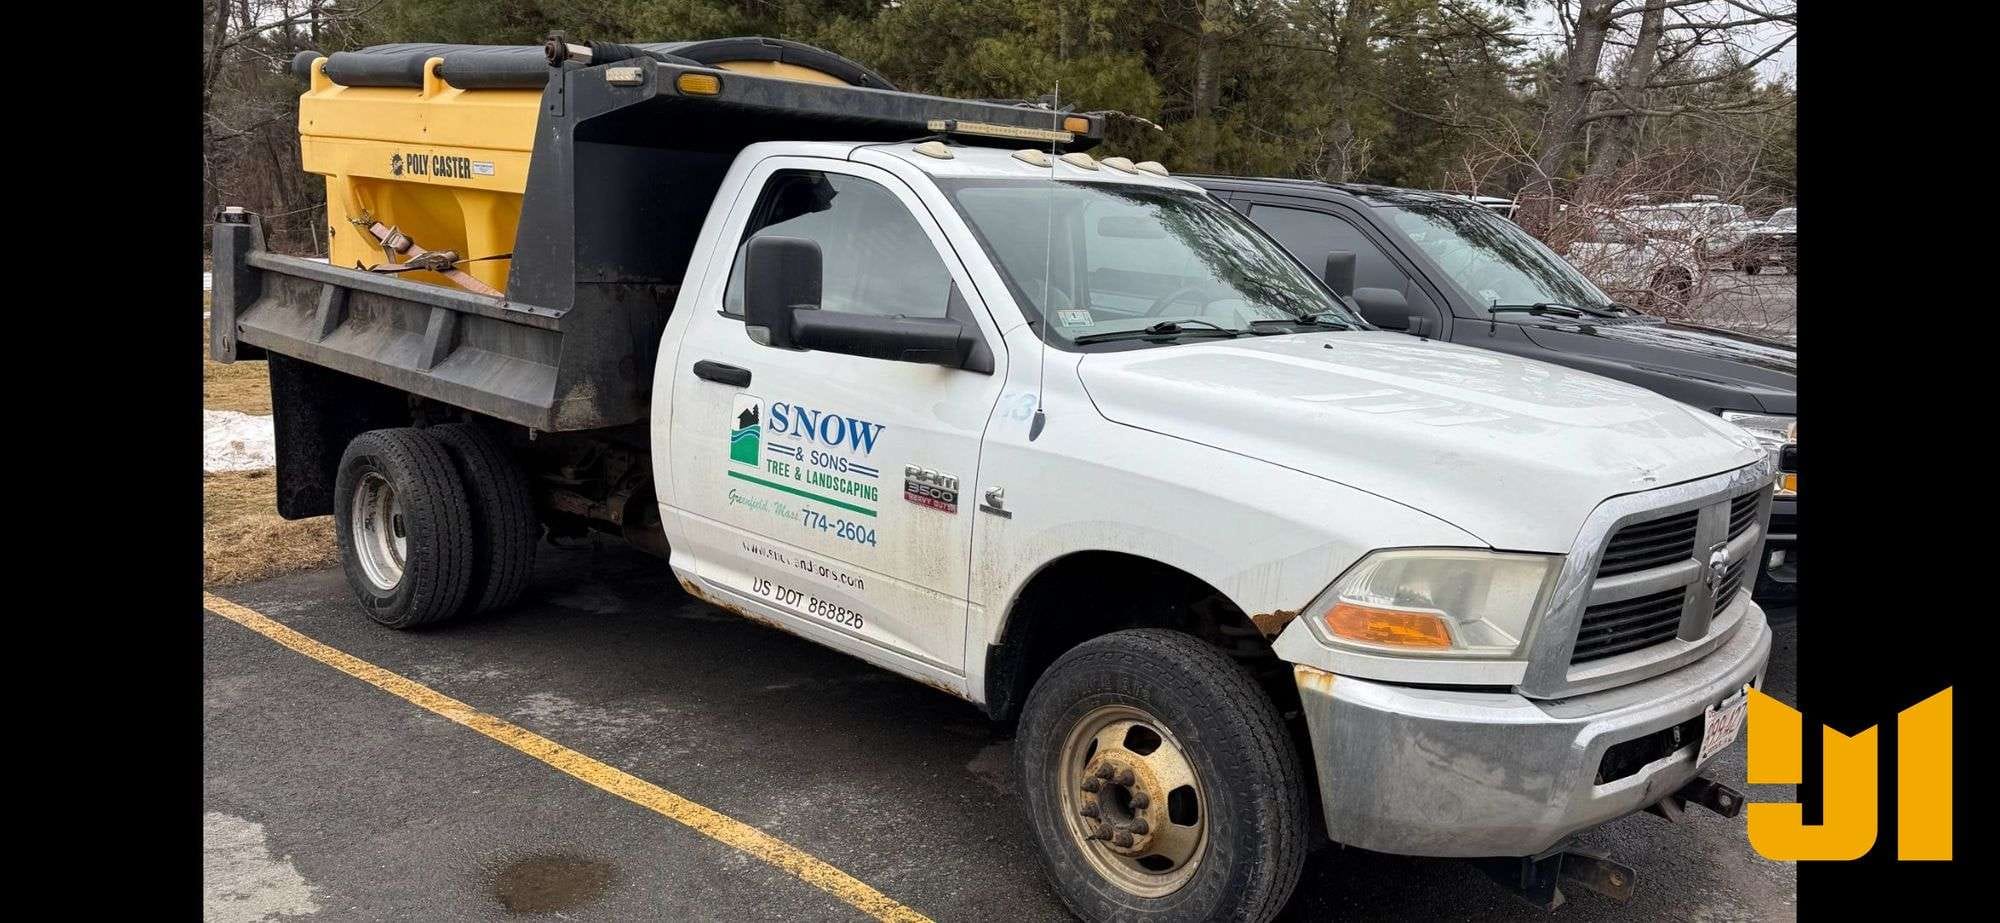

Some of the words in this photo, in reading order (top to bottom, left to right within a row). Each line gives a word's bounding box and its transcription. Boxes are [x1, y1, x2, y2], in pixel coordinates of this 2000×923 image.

[406, 153, 429, 175] POLY
[432, 154, 472, 179] CASTER
[769, 401, 886, 455] SNOW
[795, 446, 804, 462] &
[810, 449, 849, 473] SONS
[766, 458, 790, 478] TREE
[794, 466, 801, 481] &
[806, 469, 878, 502] LANDSCAPING
[904, 463, 959, 493] RAM
[908, 481, 955, 503] 3500
[802, 508, 877, 547] 774-2604
[753, 577, 771, 596] US
[776, 585, 803, 607] DOT
[808, 597, 863, 629] 868826
